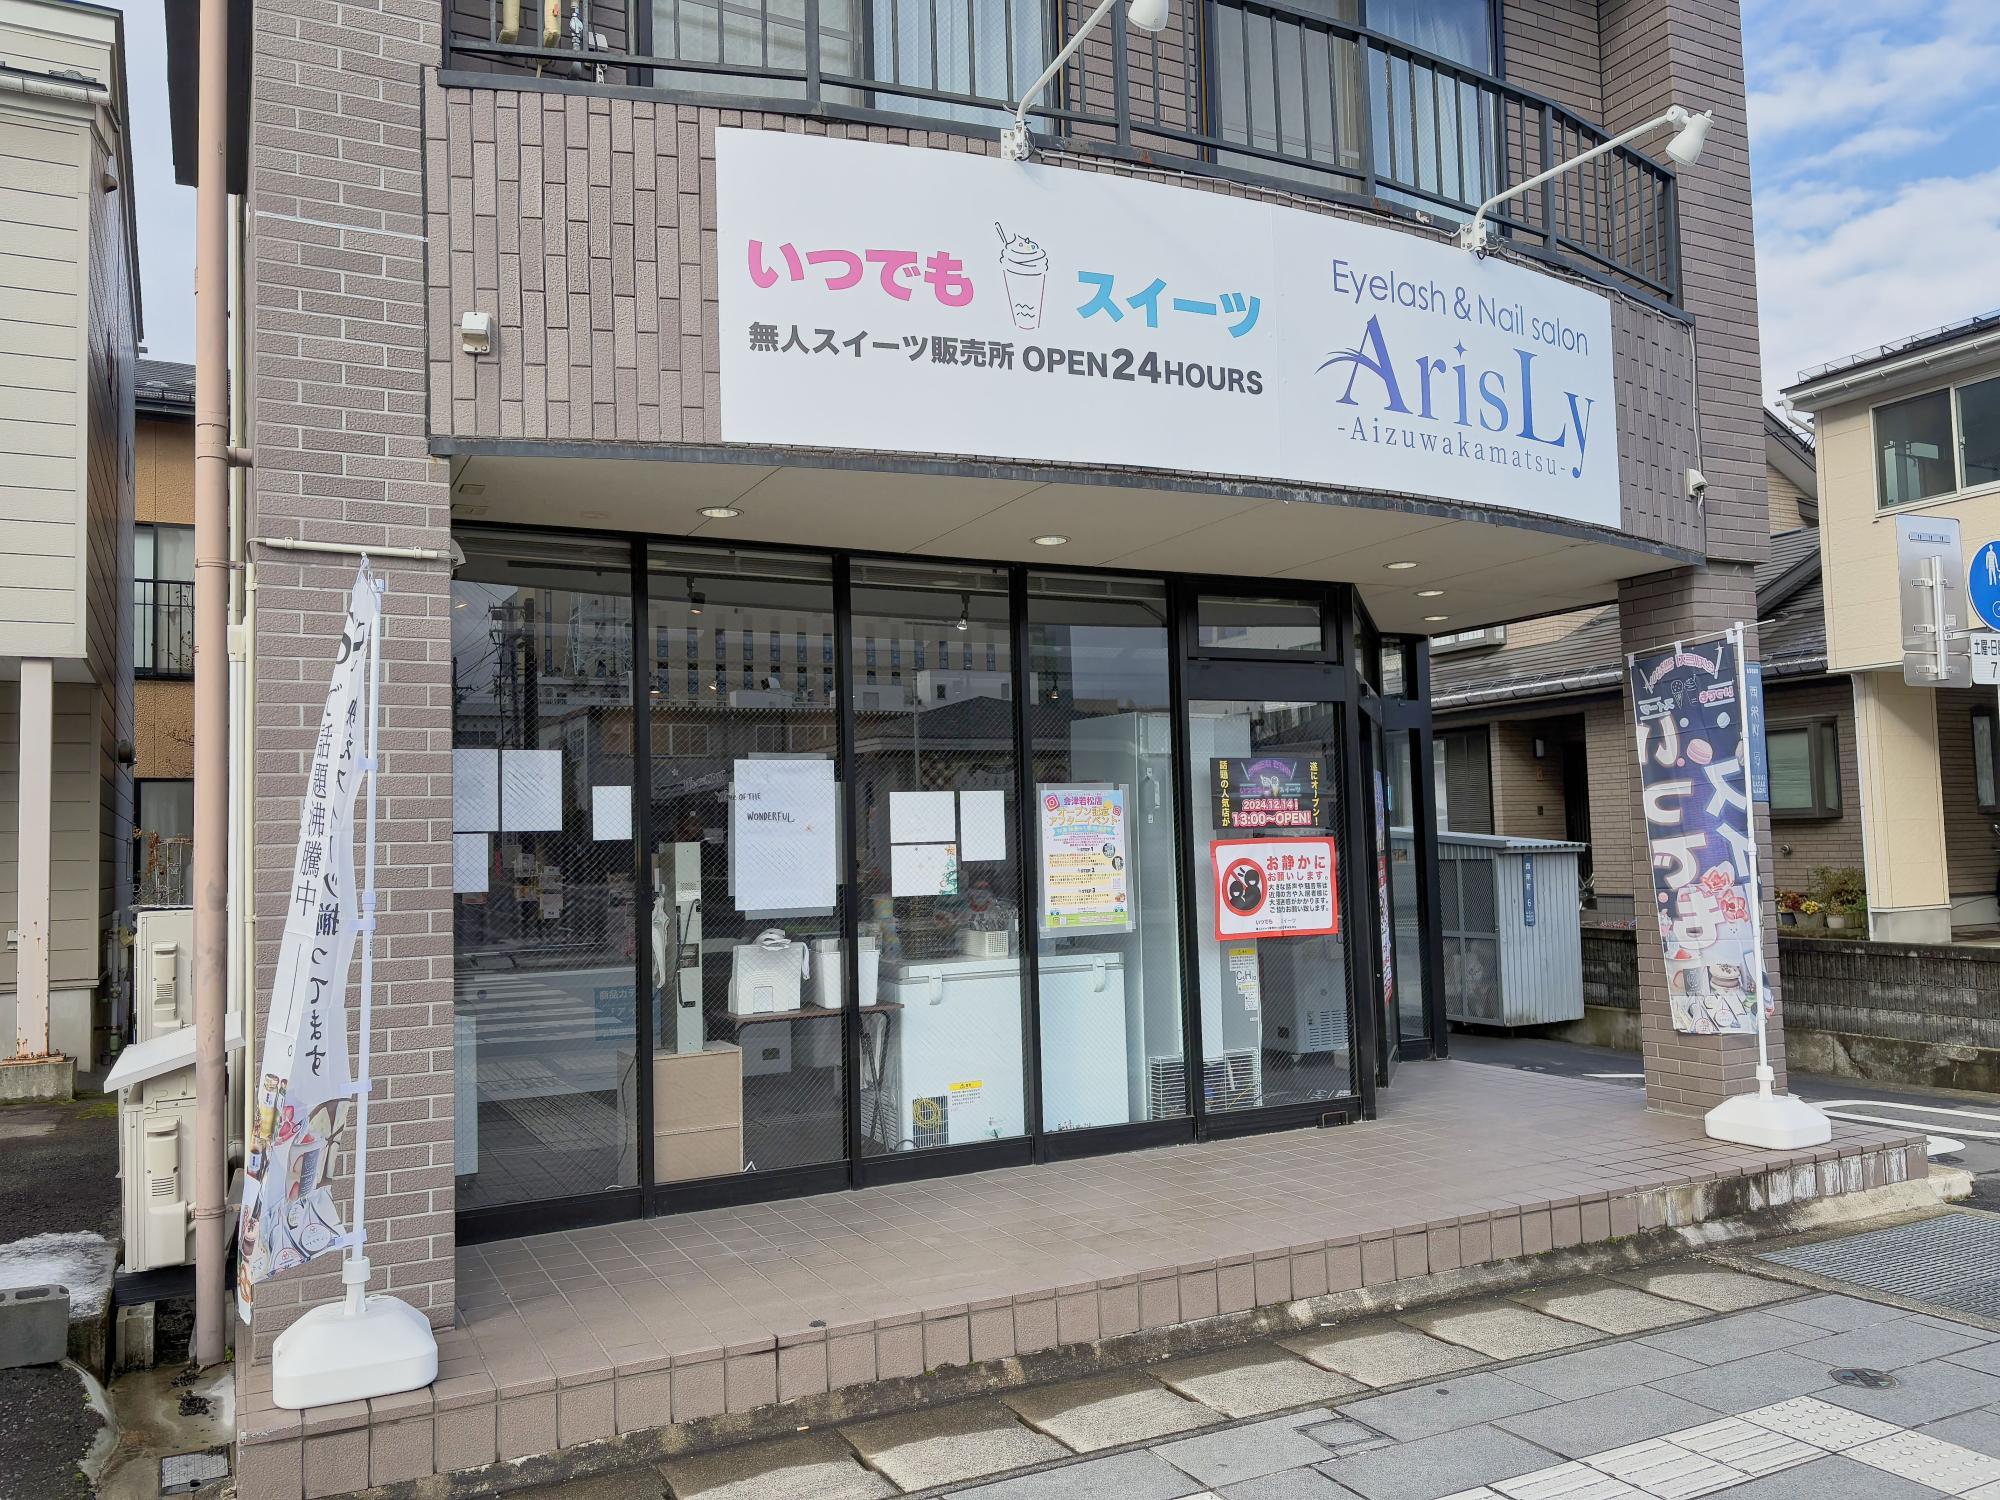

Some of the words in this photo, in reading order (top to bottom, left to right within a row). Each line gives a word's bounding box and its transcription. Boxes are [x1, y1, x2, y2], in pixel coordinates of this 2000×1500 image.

[747, 239, 974, 307] いつでも
[1076, 270, 1261, 338] スイーツ
[1333, 259, 1446, 316] Eyelash
[1453, 286, 1472, 322] &
[1478, 294, 1524, 336] Nail
[1531, 316, 1588, 356] salon
[748, 321, 1015, 371] 無人スイーツ販売所
[1315, 314, 1595, 478] ArisLy
[1219, 760, 1231, 827] 話題の人気店が
[1266, 855, 1326, 871] お静かに
[1267, 871, 1329, 882] お願いします。
